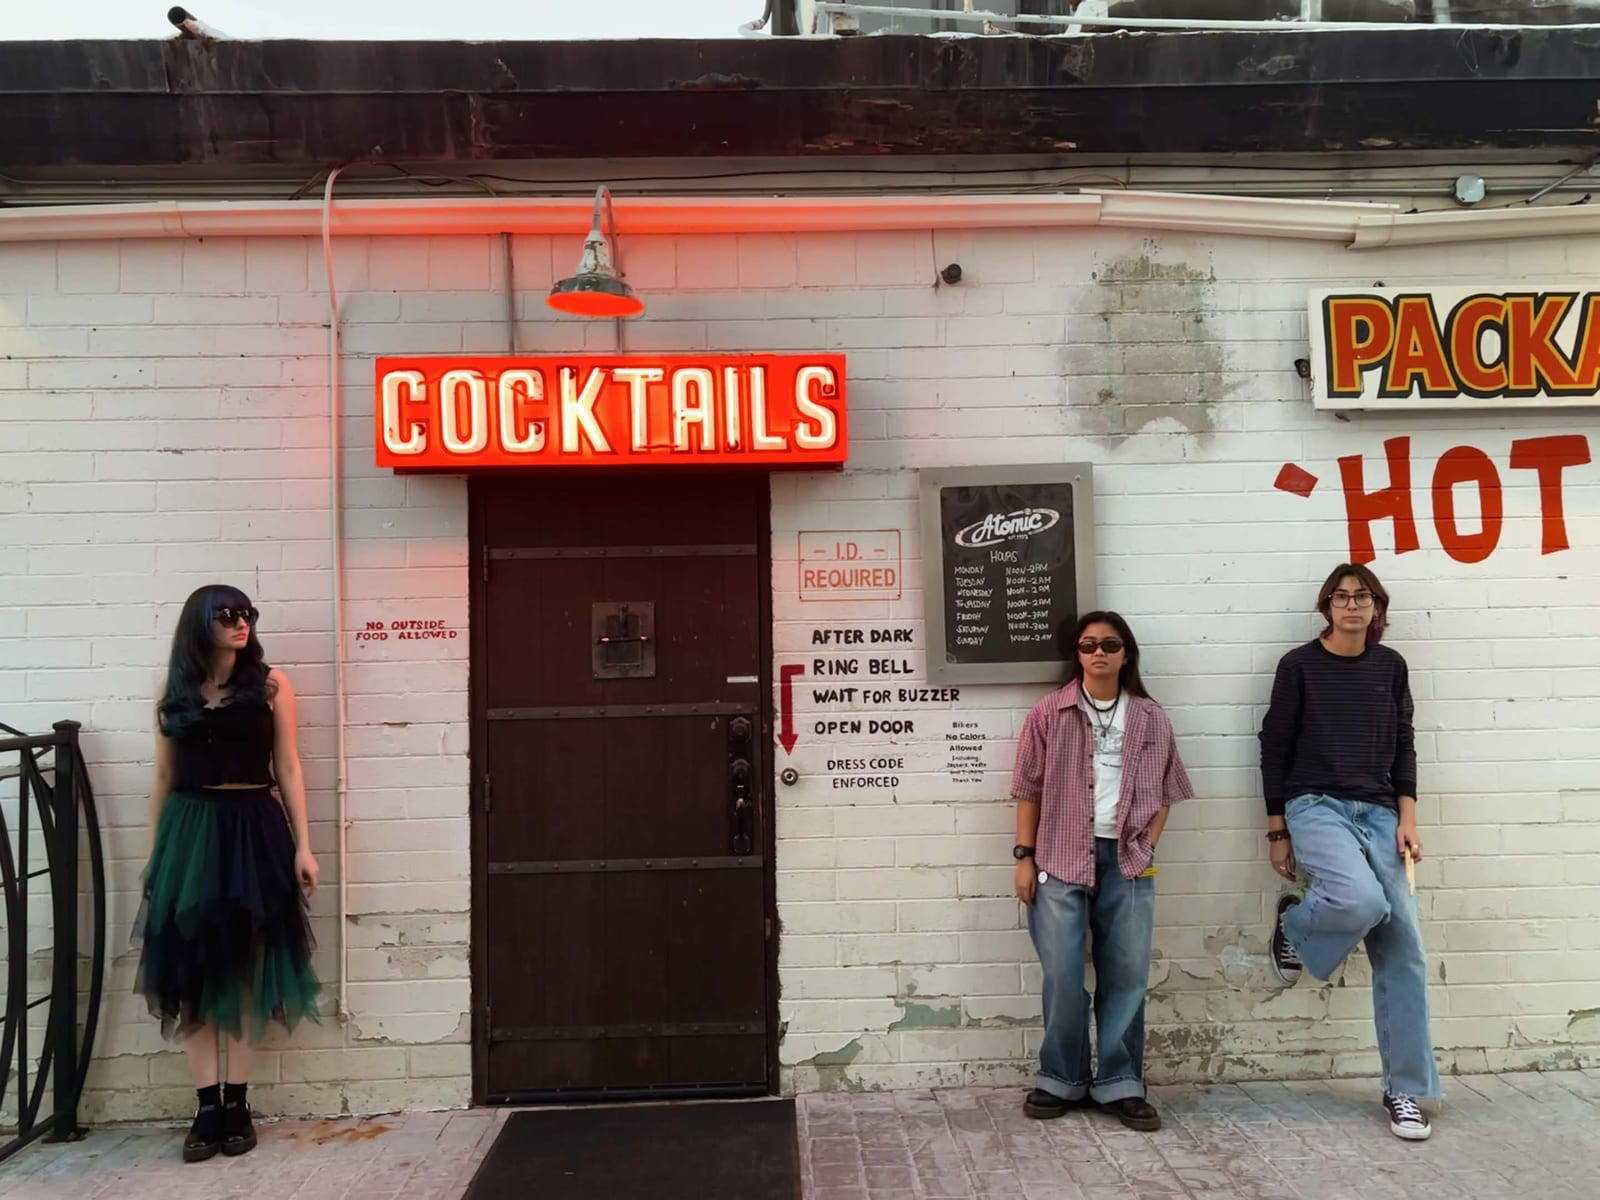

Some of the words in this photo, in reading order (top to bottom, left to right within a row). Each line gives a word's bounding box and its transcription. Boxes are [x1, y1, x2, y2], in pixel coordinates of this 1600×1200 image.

[379, 365, 840, 455] COCKTAILS
[1337, 435, 1591, 564] HOT
[971, 514, 1042, 543] Atomic
[836, 542, 862, 560] I.D.
[990, 551, 1018, 562] HOURS
[954, 566, 984, 574] MONDAY
[804, 569, 895, 588] REQUIRED
[956, 577, 985, 587] TUESDAY
[366, 622, 384, 630] NO
[391, 620, 445, 630] OUTSIDE
[356, 632, 388, 640] FOOD
[398, 631, 457, 639] ALLOWED
[812, 629, 864, 644] AFTER
[871, 629, 913, 642] DARK
[813, 659, 858, 675] RING
[869, 659, 914, 674] BELL
[813, 688, 858, 703] WAIT
[864, 690, 892, 703] FOR
[899, 688, 960, 702] BUZZER
[814, 721, 861, 734] OPEN
[869, 721, 914, 734] DOOR
[827, 759, 865, 770] DRESS
[870, 758, 904, 768] CODE
[832, 777, 899, 788] ENFORCED
